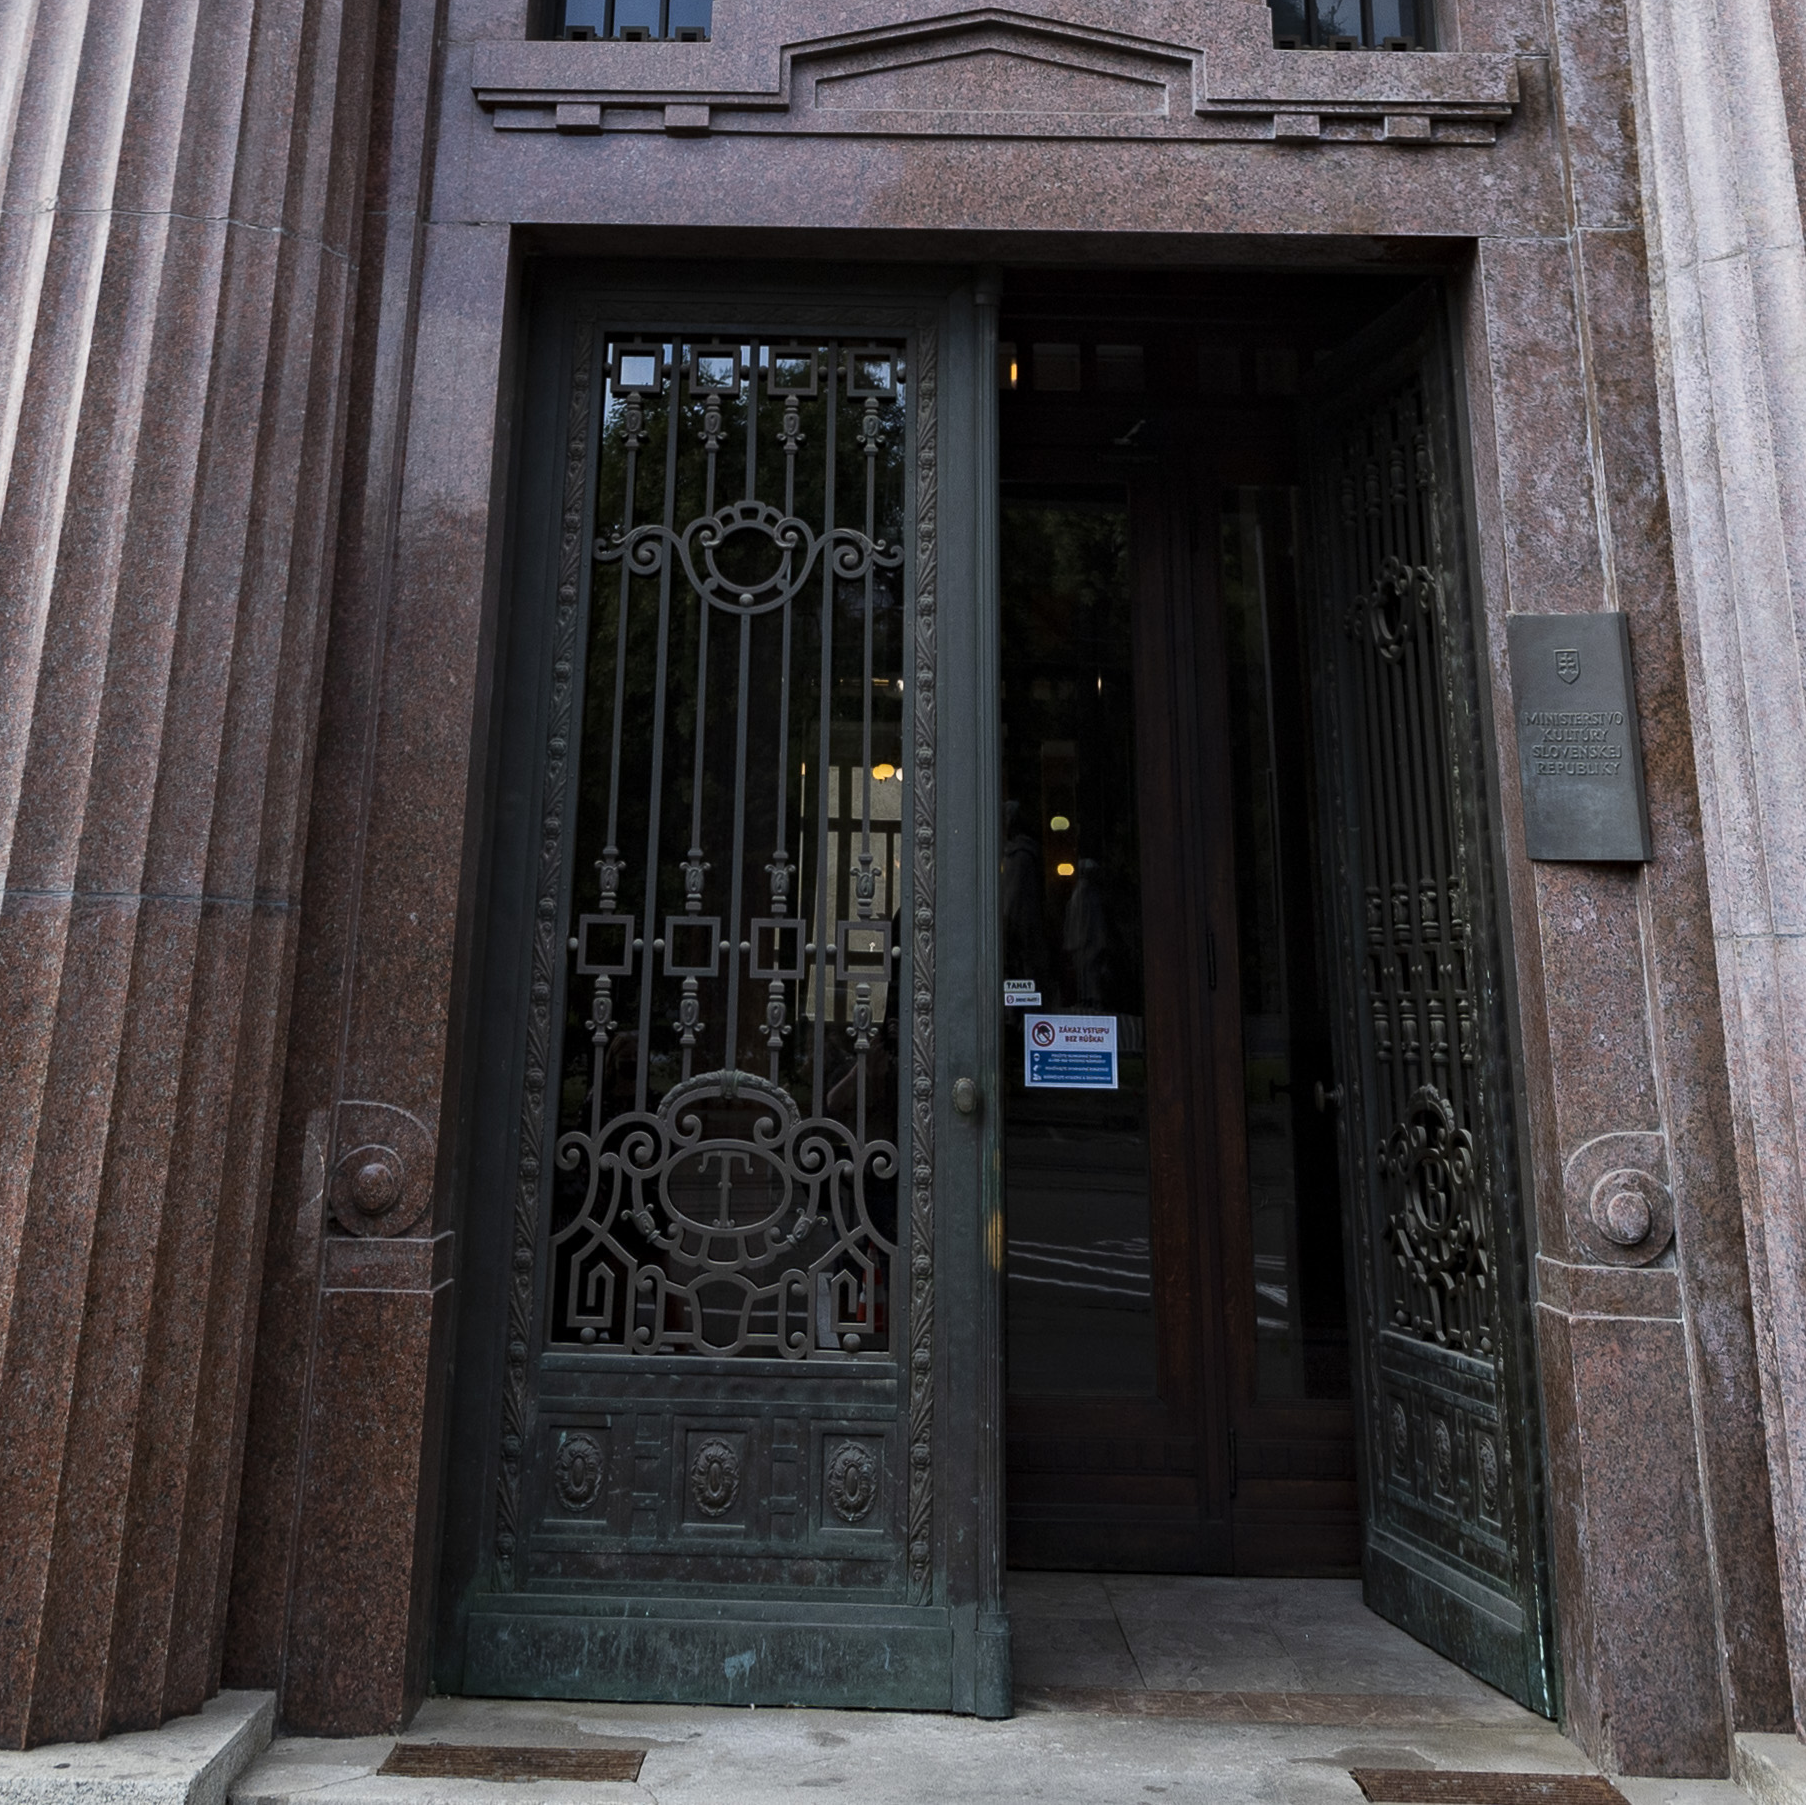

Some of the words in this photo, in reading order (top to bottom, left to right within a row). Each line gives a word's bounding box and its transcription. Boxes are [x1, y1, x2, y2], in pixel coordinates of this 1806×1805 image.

[1524, 711, 1624, 727] MINISTERSTVO
[1542, 726, 1609, 743] KULTÚRY
[1532, 745, 1623, 760] SLOVENSKEJ
[1536, 762, 1621, 776] REPUBLIKY
[1058, 1025, 1082, 1034] ZÁKAZ
[1082, 1026, 1110, 1035] VSTUPU
[1065, 1035, 1077, 1043] BEZ
